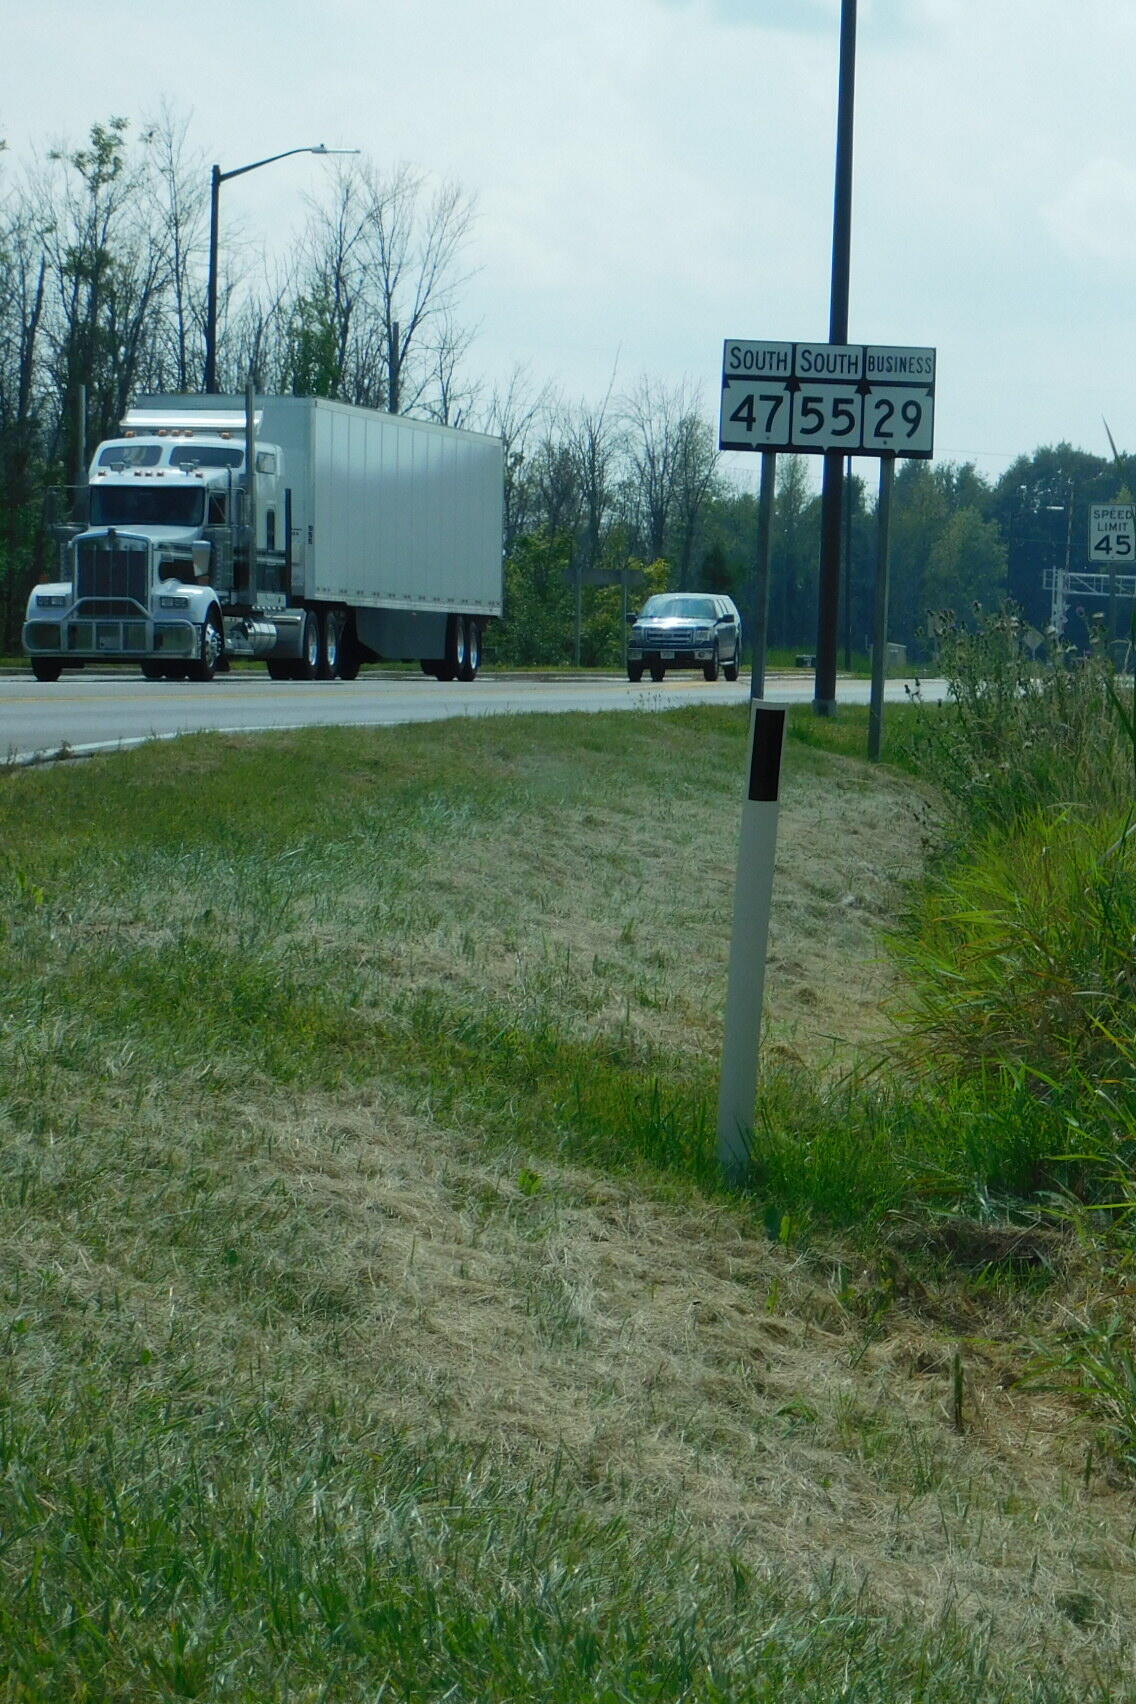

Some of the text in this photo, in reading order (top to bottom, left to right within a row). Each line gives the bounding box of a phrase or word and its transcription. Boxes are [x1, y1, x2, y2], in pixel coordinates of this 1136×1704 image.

[730, 346, 788, 371] SOUTH
[800, 349, 859, 374] SOUTH
[867, 355, 932, 374] BUSINESS
[729, 394, 784, 432] 47
[800, 396, 856, 436] 55
[874, 399, 922, 438] 29
[1093, 510, 1133, 519] SPEED
[1097, 523, 1128, 531] LIMIT
[1094, 535, 1131, 555] 45
